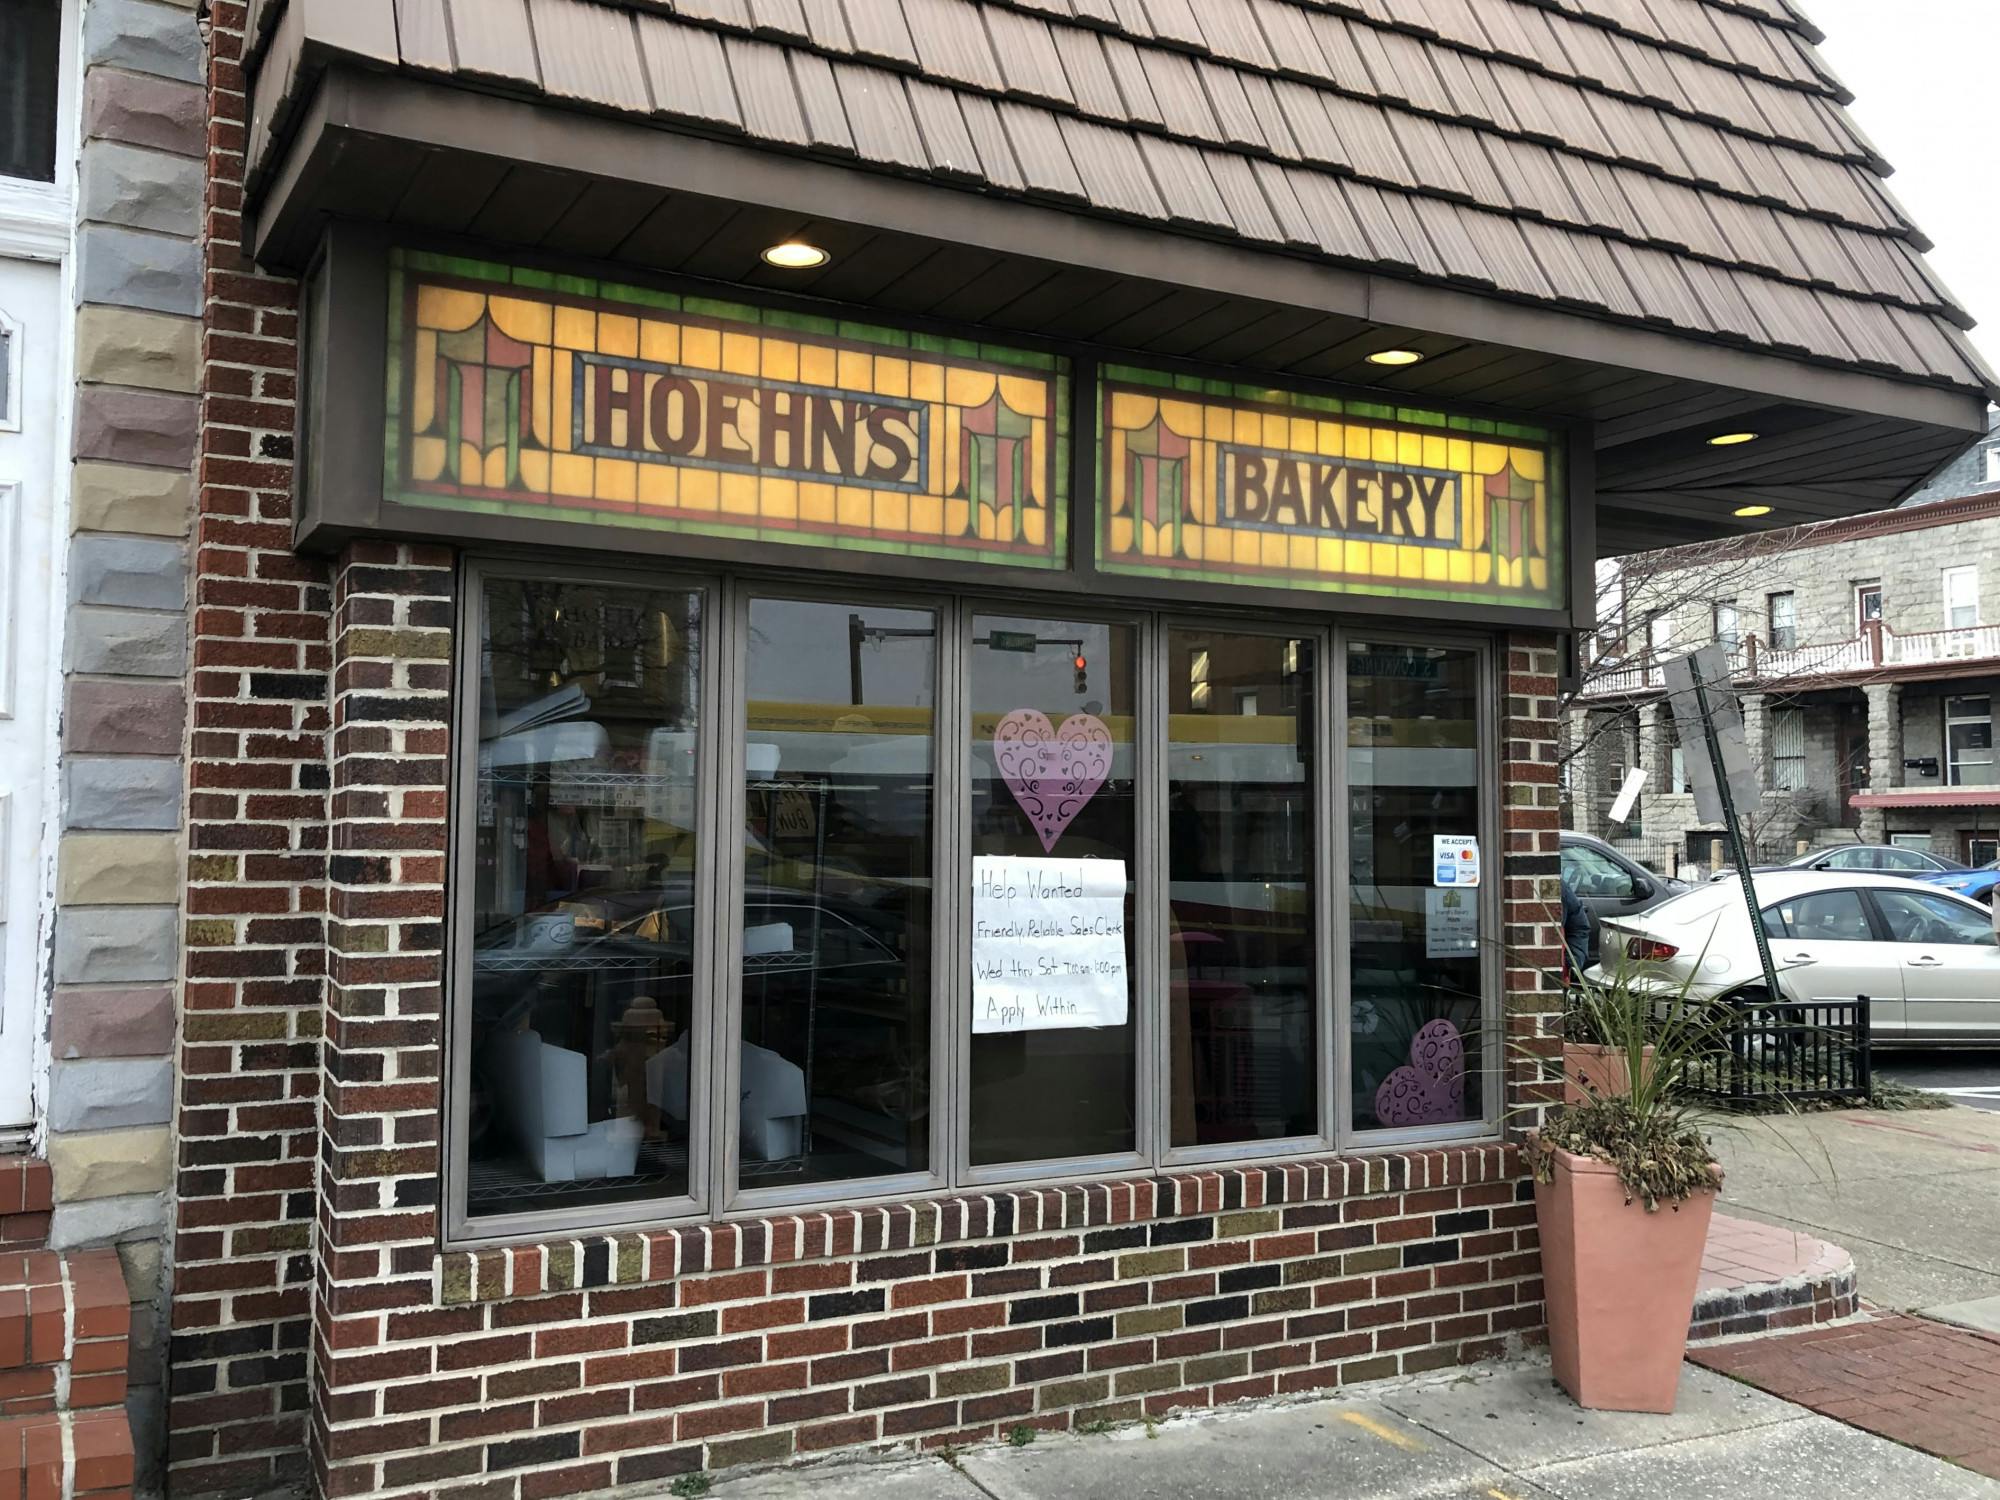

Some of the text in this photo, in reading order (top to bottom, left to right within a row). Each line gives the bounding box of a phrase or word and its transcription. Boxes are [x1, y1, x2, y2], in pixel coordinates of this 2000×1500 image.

[594, 364, 912, 482] HOEHN'S
[1234, 452, 1448, 540] BAKERY
[1440, 852, 1455, 860] VISA
[982, 867, 1083, 909] Help Wanted
[1027, 919, 1064, 938] Reliable
[1094, 915, 1122, 937] Clerk
[976, 959, 1003, 980] Wed
[1010, 959, 1033, 977] thru
[1038, 956, 1059, 976] Sat
[987, 994, 1077, 1026] Apply Within
